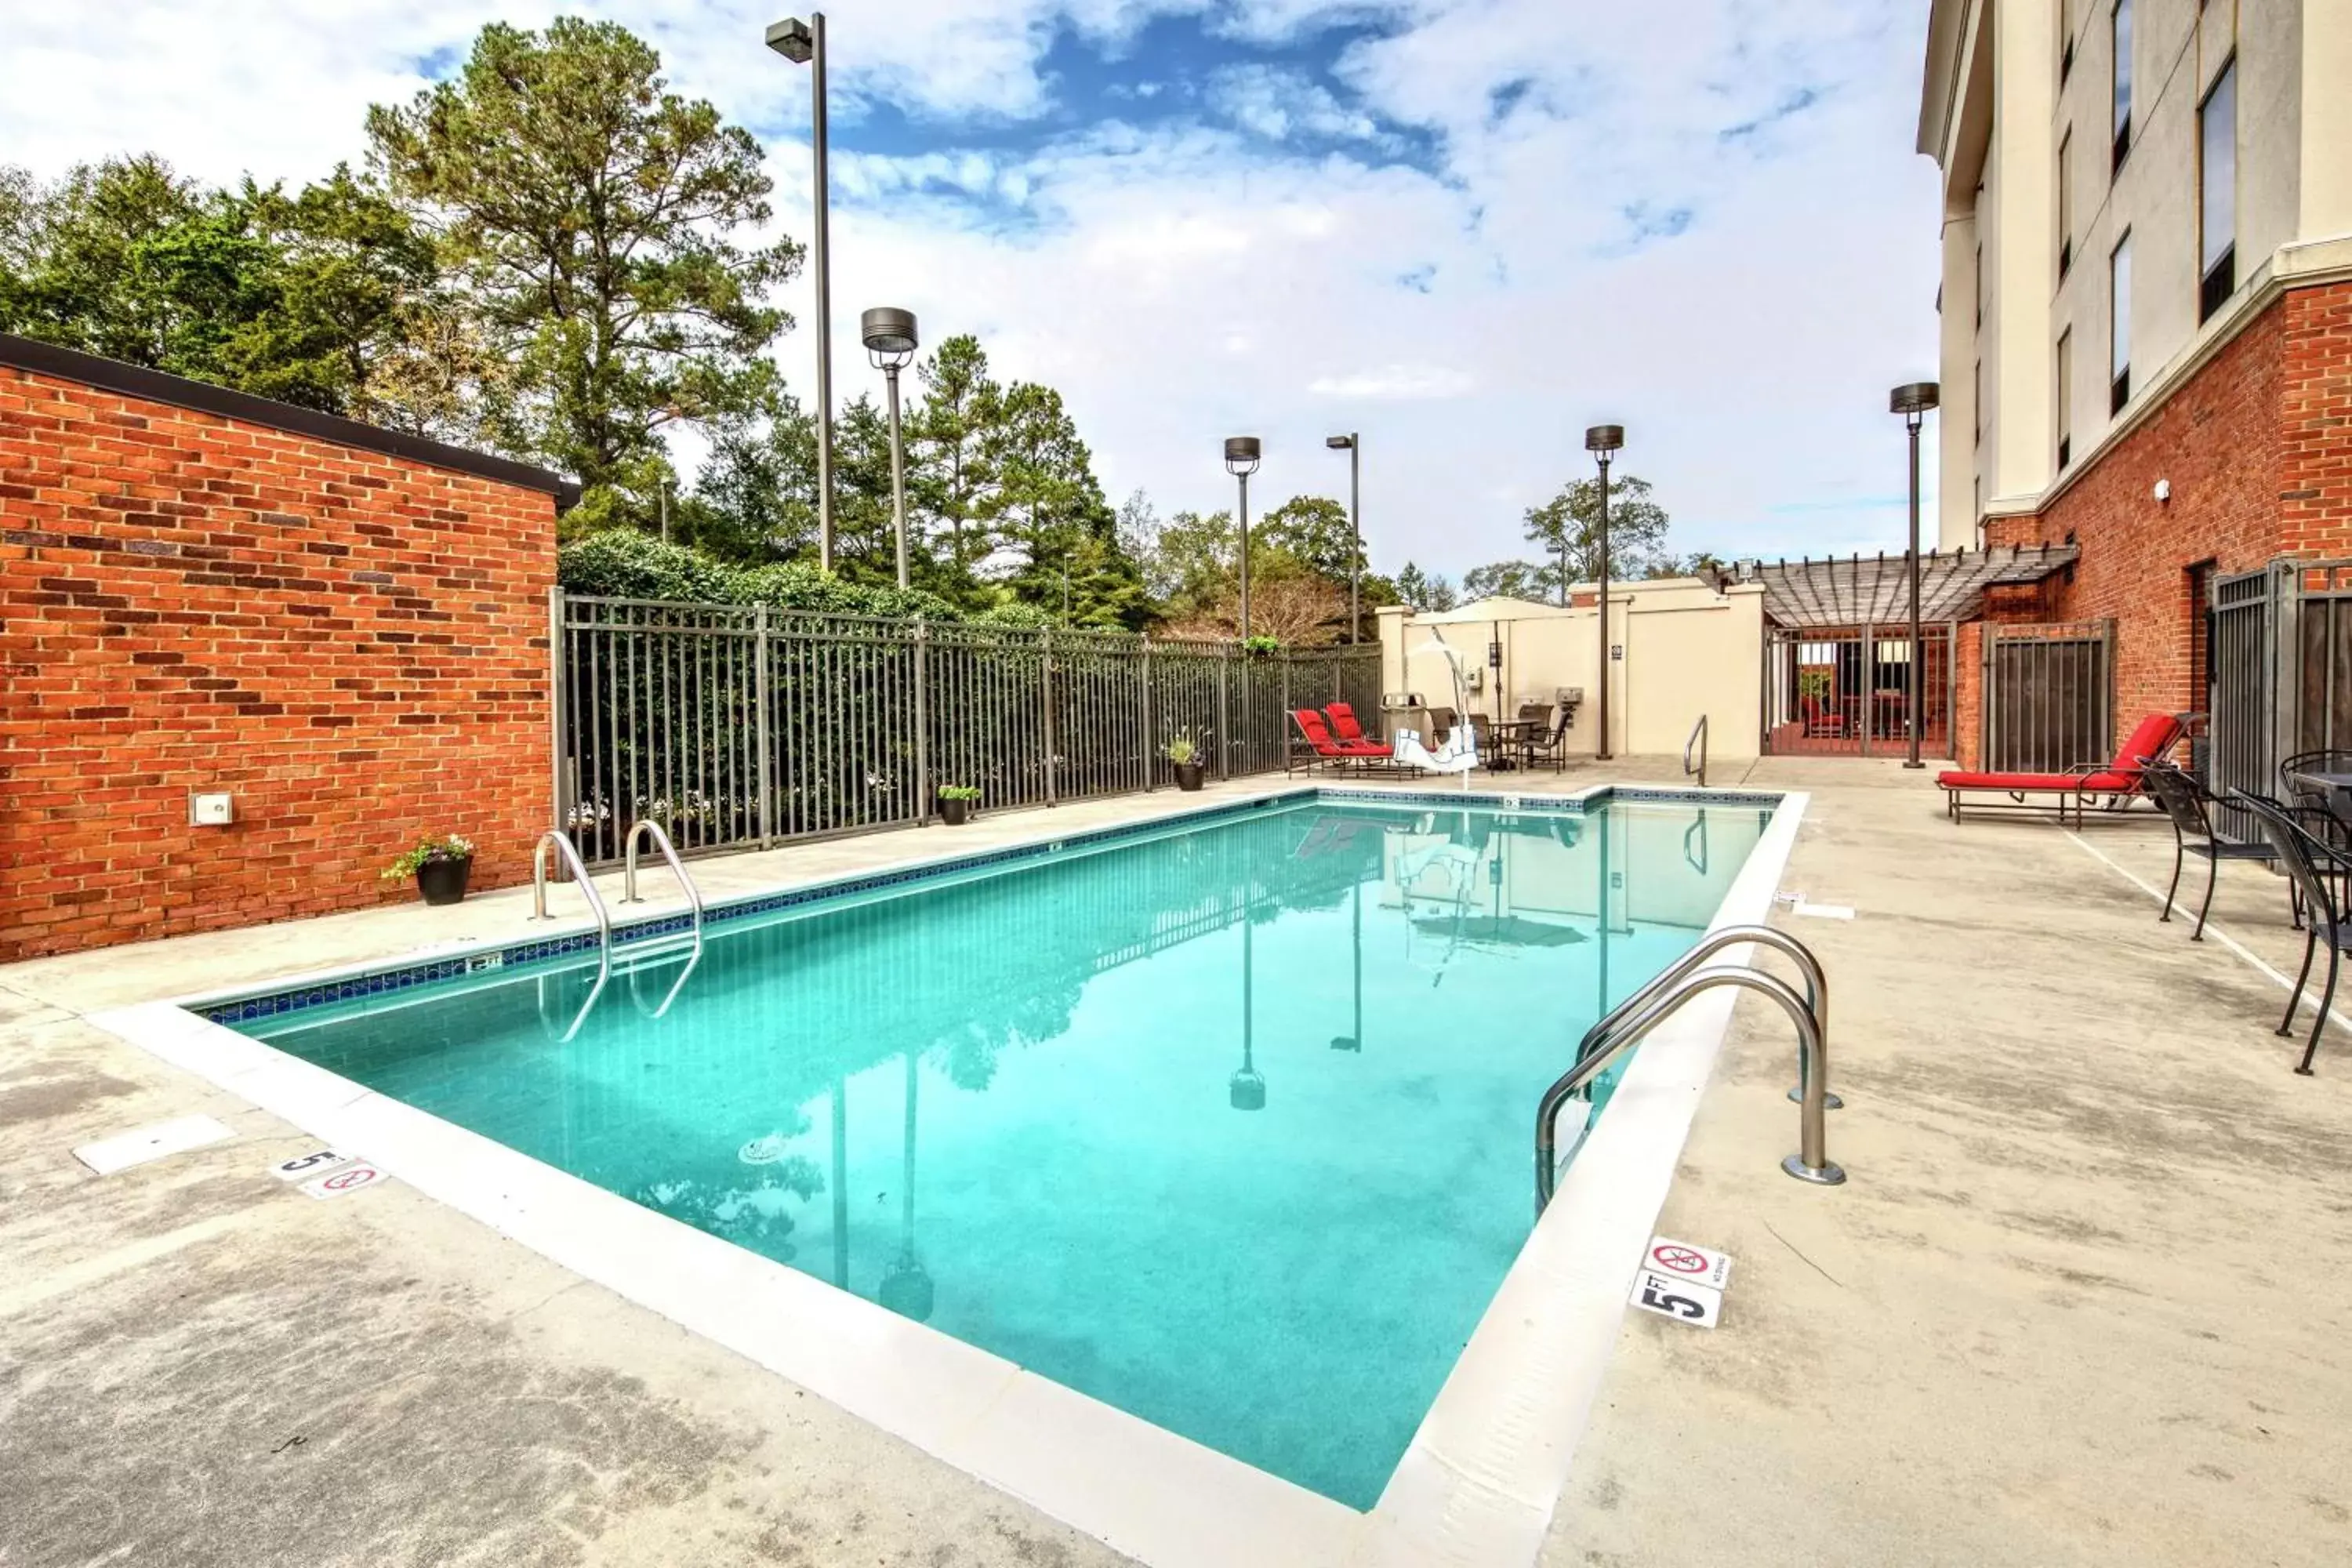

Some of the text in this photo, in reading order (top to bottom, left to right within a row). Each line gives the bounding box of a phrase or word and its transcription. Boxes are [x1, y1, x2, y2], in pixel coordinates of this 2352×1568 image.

[281, 1151, 336, 1171] 5
[1641, 1274, 1705, 1319] 5 FT
